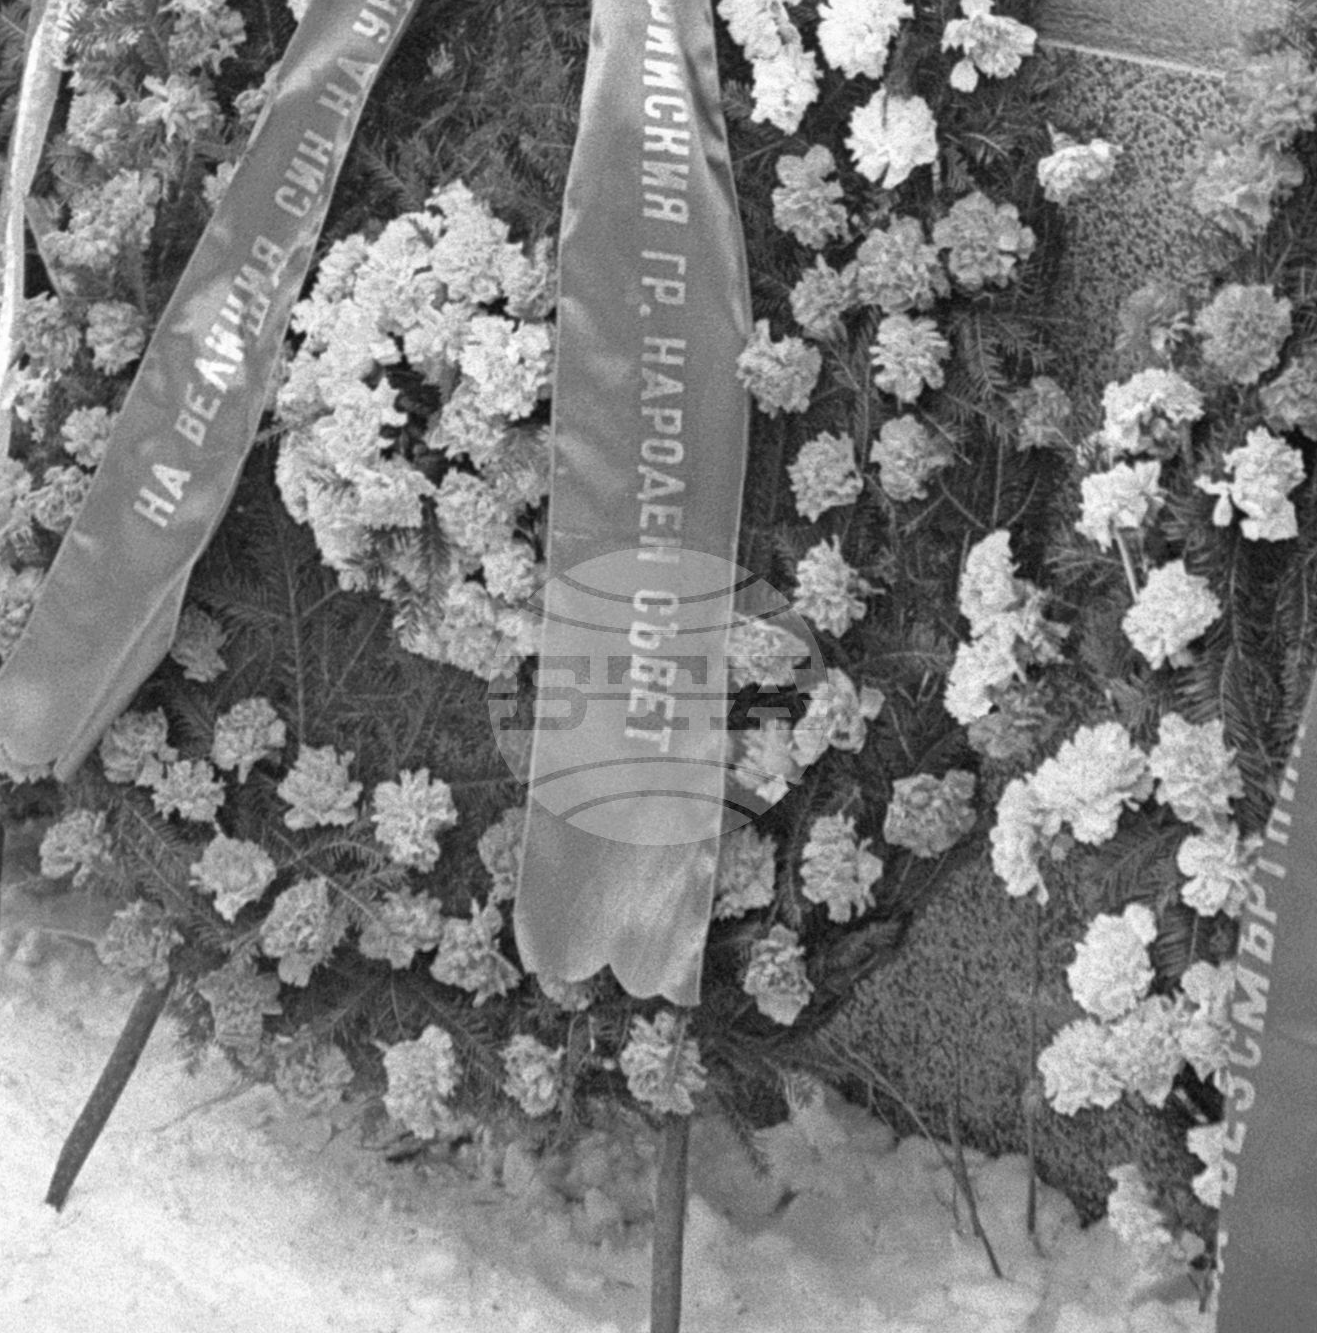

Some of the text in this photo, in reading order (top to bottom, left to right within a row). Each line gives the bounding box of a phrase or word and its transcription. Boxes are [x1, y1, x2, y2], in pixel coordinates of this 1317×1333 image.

[132, 460, 192, 529] НА
[275, 128, 336, 225] СИН
[317, 50, 375, 119] НА
[637, 248, 686, 318] ГР.
[634, 336, 687, 563] НАРОДЕН
[624, 588, 680, 753] СЪВЕТ
